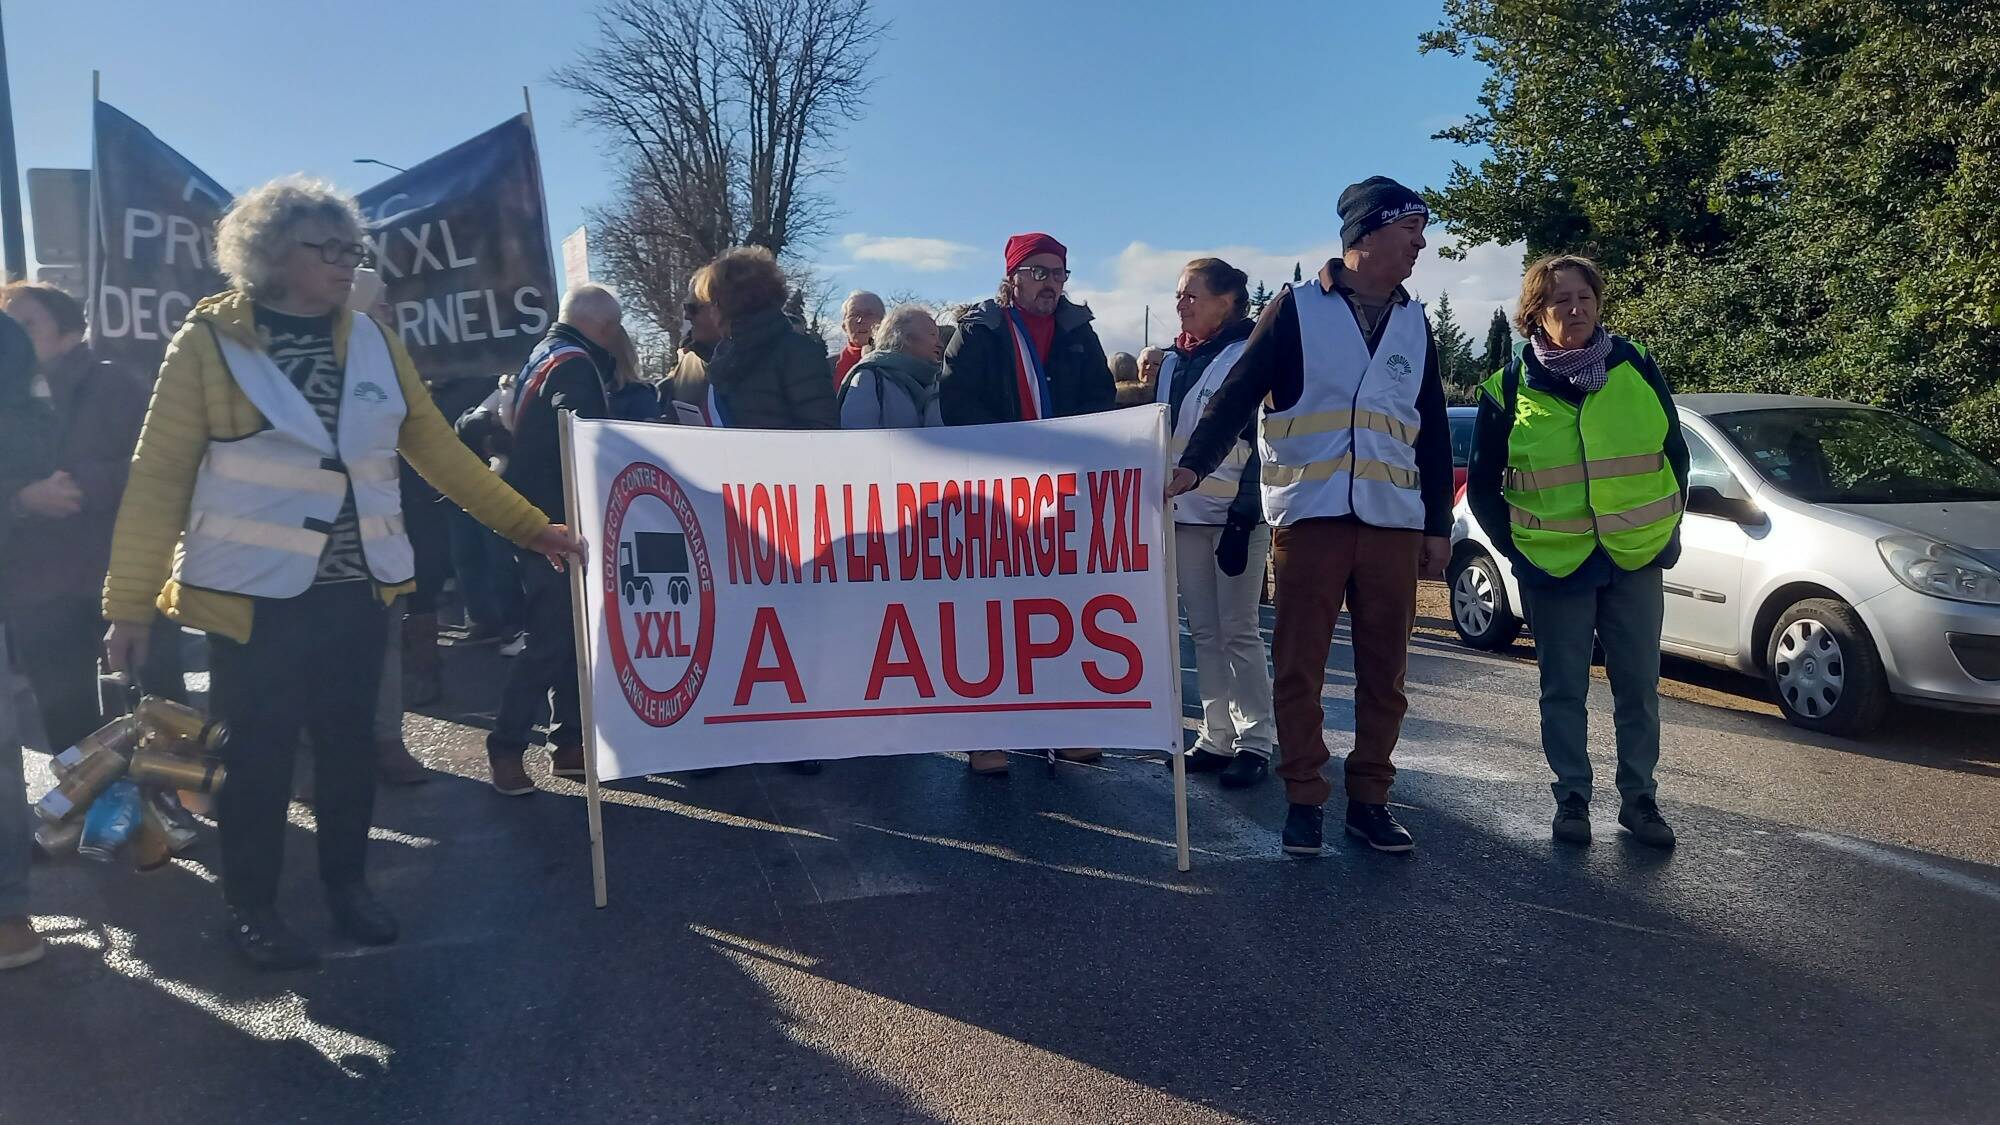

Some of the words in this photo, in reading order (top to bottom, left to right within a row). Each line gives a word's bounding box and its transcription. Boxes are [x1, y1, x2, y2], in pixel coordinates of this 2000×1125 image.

[371, 220, 477, 278] XXL
[100, 285, 192, 341] DEG
[396, 286, 548, 346] RNELS
[605, 486, 625, 593] COLLECTIF
[621, 467, 658, 496] CONTRE
[659, 474, 673, 500] LA
[672, 490, 712, 593] DECHARGE
[722, 483, 802, 586] NON
[813, 484, 838, 583] A
[843, 483, 891, 583] LA
[896, 473, 1078, 582] DECHARGE
[1087, 468, 1149, 574] XXL
[633, 611, 691, 659] XXL
[733, 607, 807, 706] A
[864, 594, 1144, 700] AUPS
[621, 663, 646, 711] DANS
[644, 696, 657, 720] LE
[658, 661, 704, 721] HAUT-VAR
